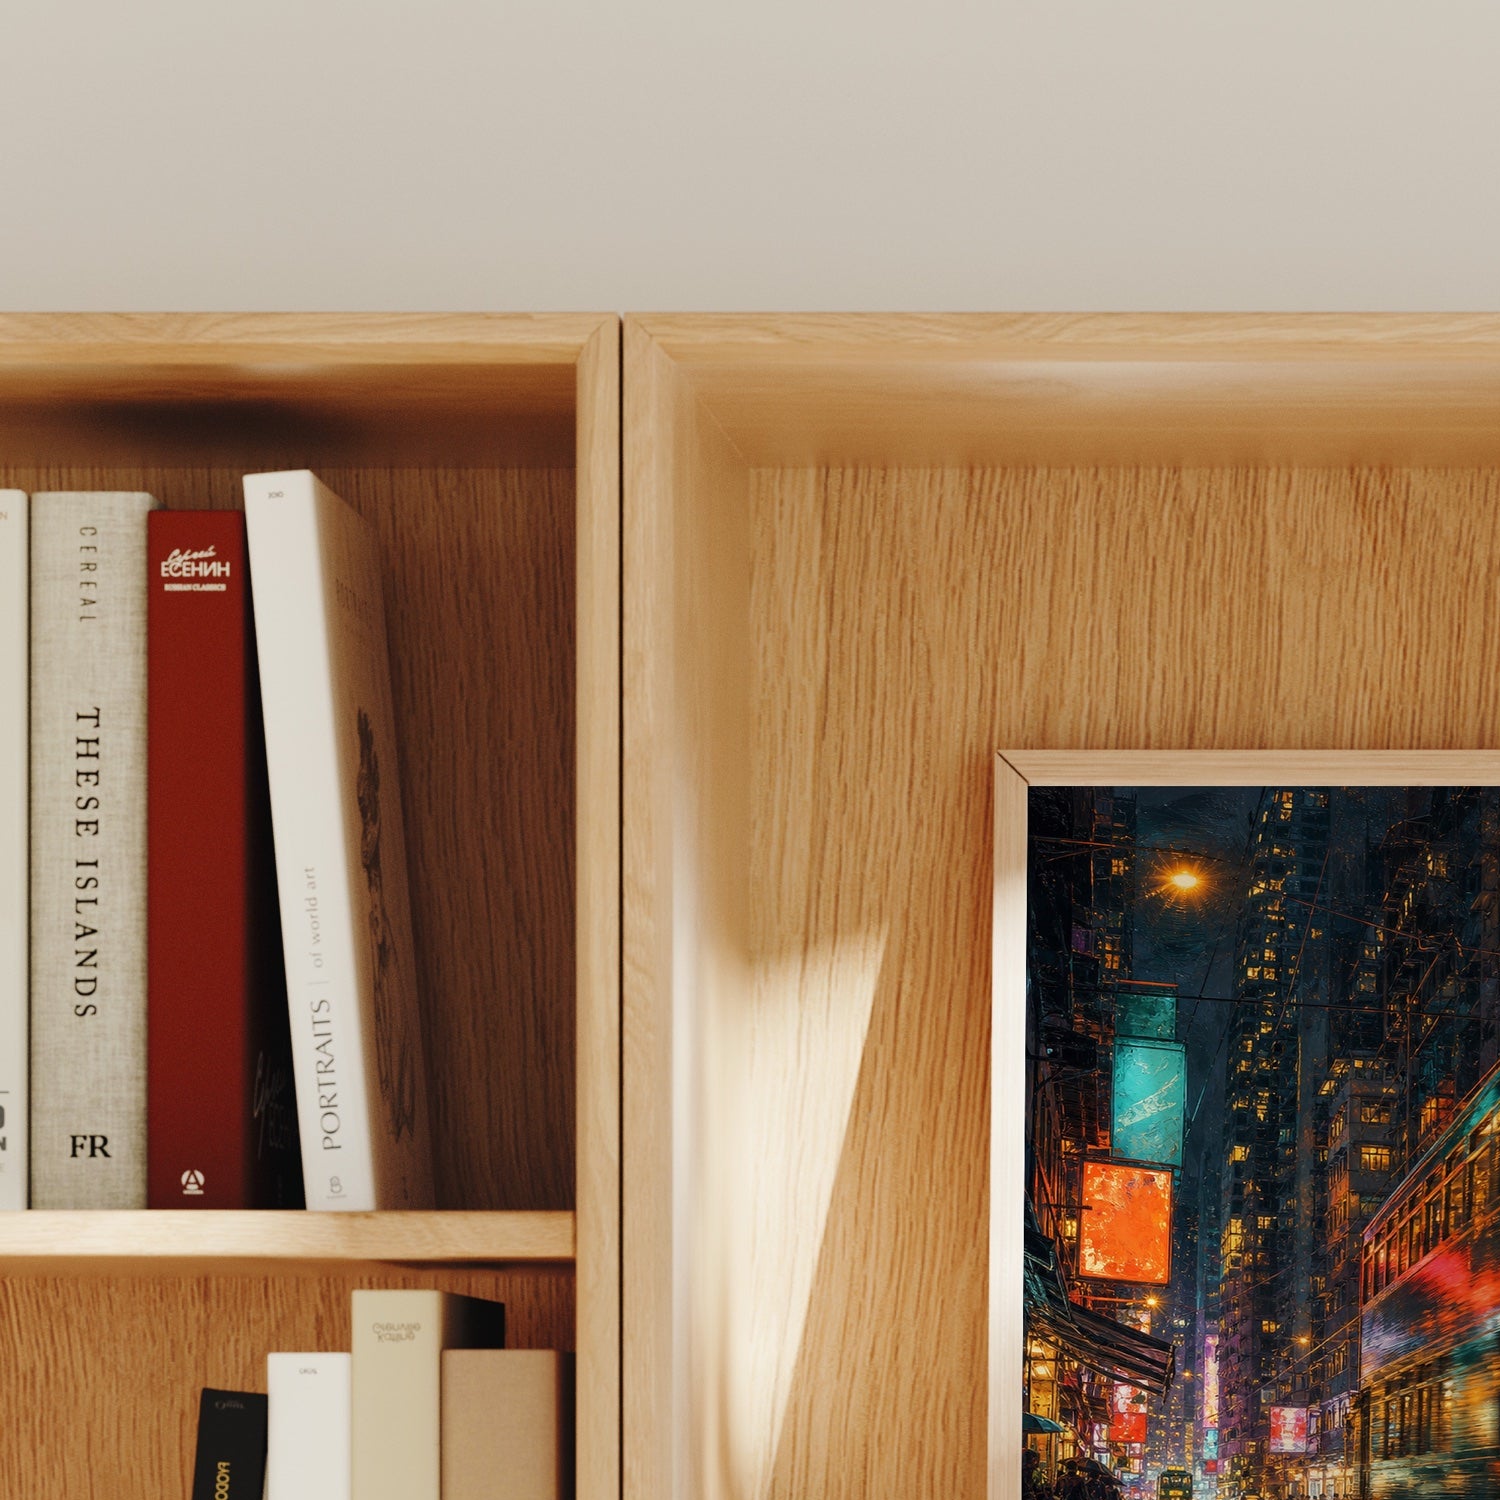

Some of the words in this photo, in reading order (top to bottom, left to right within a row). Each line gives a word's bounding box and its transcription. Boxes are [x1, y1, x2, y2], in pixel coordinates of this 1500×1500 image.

[79, 526, 97, 622] CEREAL
[161, 561, 230, 578] ЕСЕНИН
[75, 707, 100, 836] THESE
[304, 867, 317, 890] art
[74, 860, 99, 1017] ISLANDS
[305, 896, 322, 945] world
[313, 952, 323, 969] of
[310, 999, 343, 1151] PORTRAITS
[70, 1134, 112, 1158] FR
